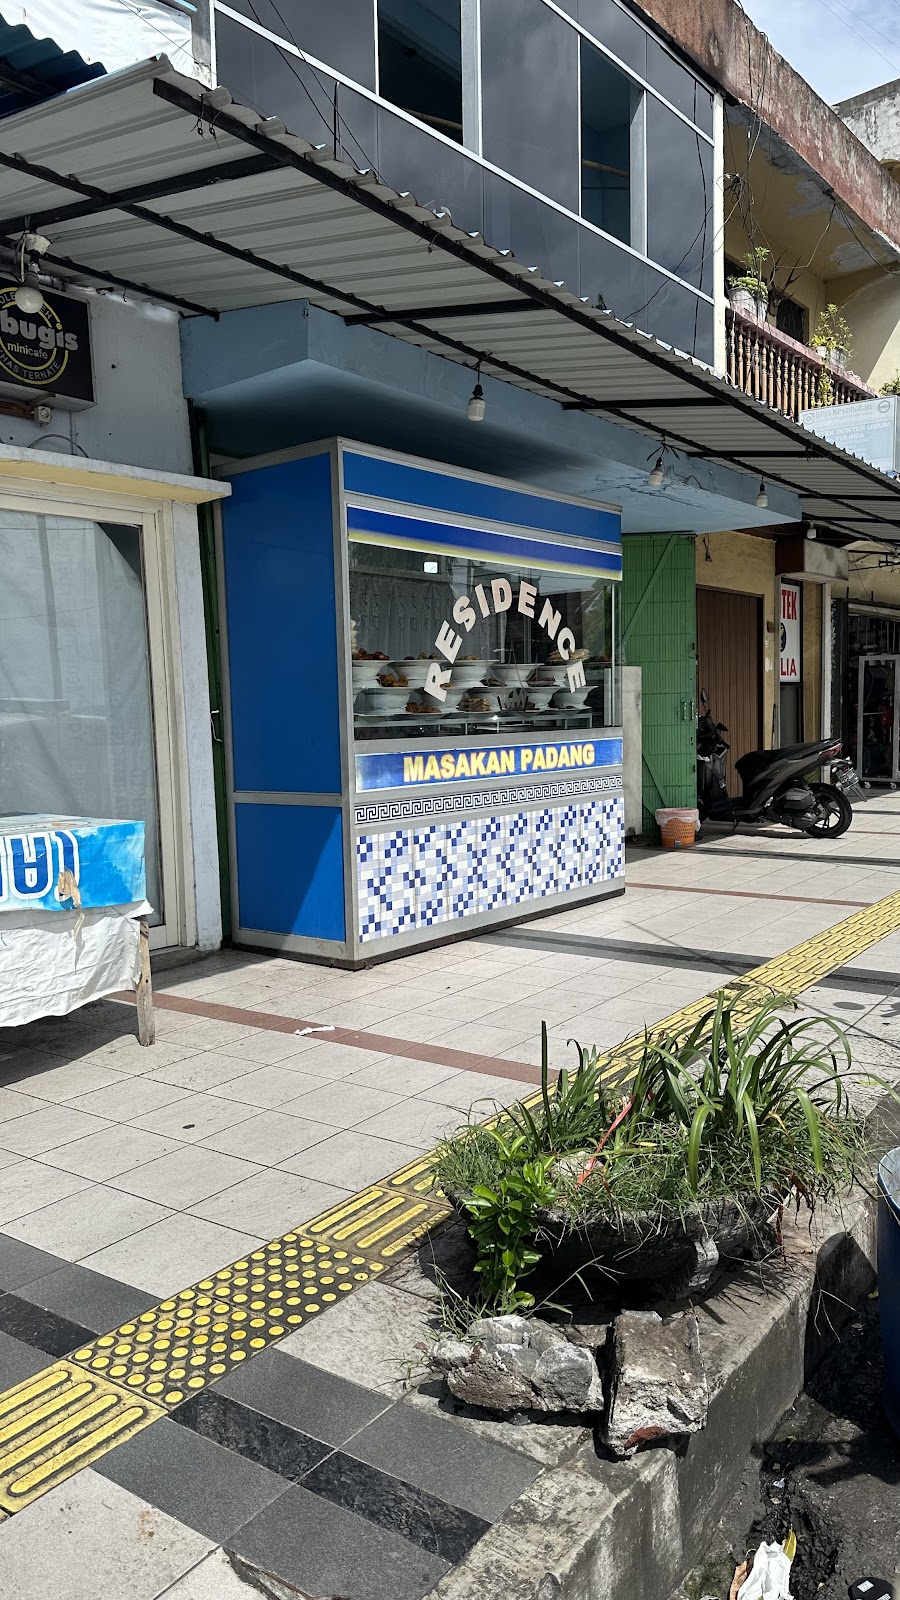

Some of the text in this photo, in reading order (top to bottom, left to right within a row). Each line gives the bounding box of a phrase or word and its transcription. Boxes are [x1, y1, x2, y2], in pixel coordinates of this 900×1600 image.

[0, 309, 79, 351] bugis
[7, 343, 48, 360] minicafe
[22, 361, 60, 380] TERNATE
[832, 404, 872, 416] Kesehatan
[836, 425, 866, 435] DOKTER
[424, 577, 587, 703] RESIDENCE
[403, 743, 595, 783] MASAKAN PADANG
